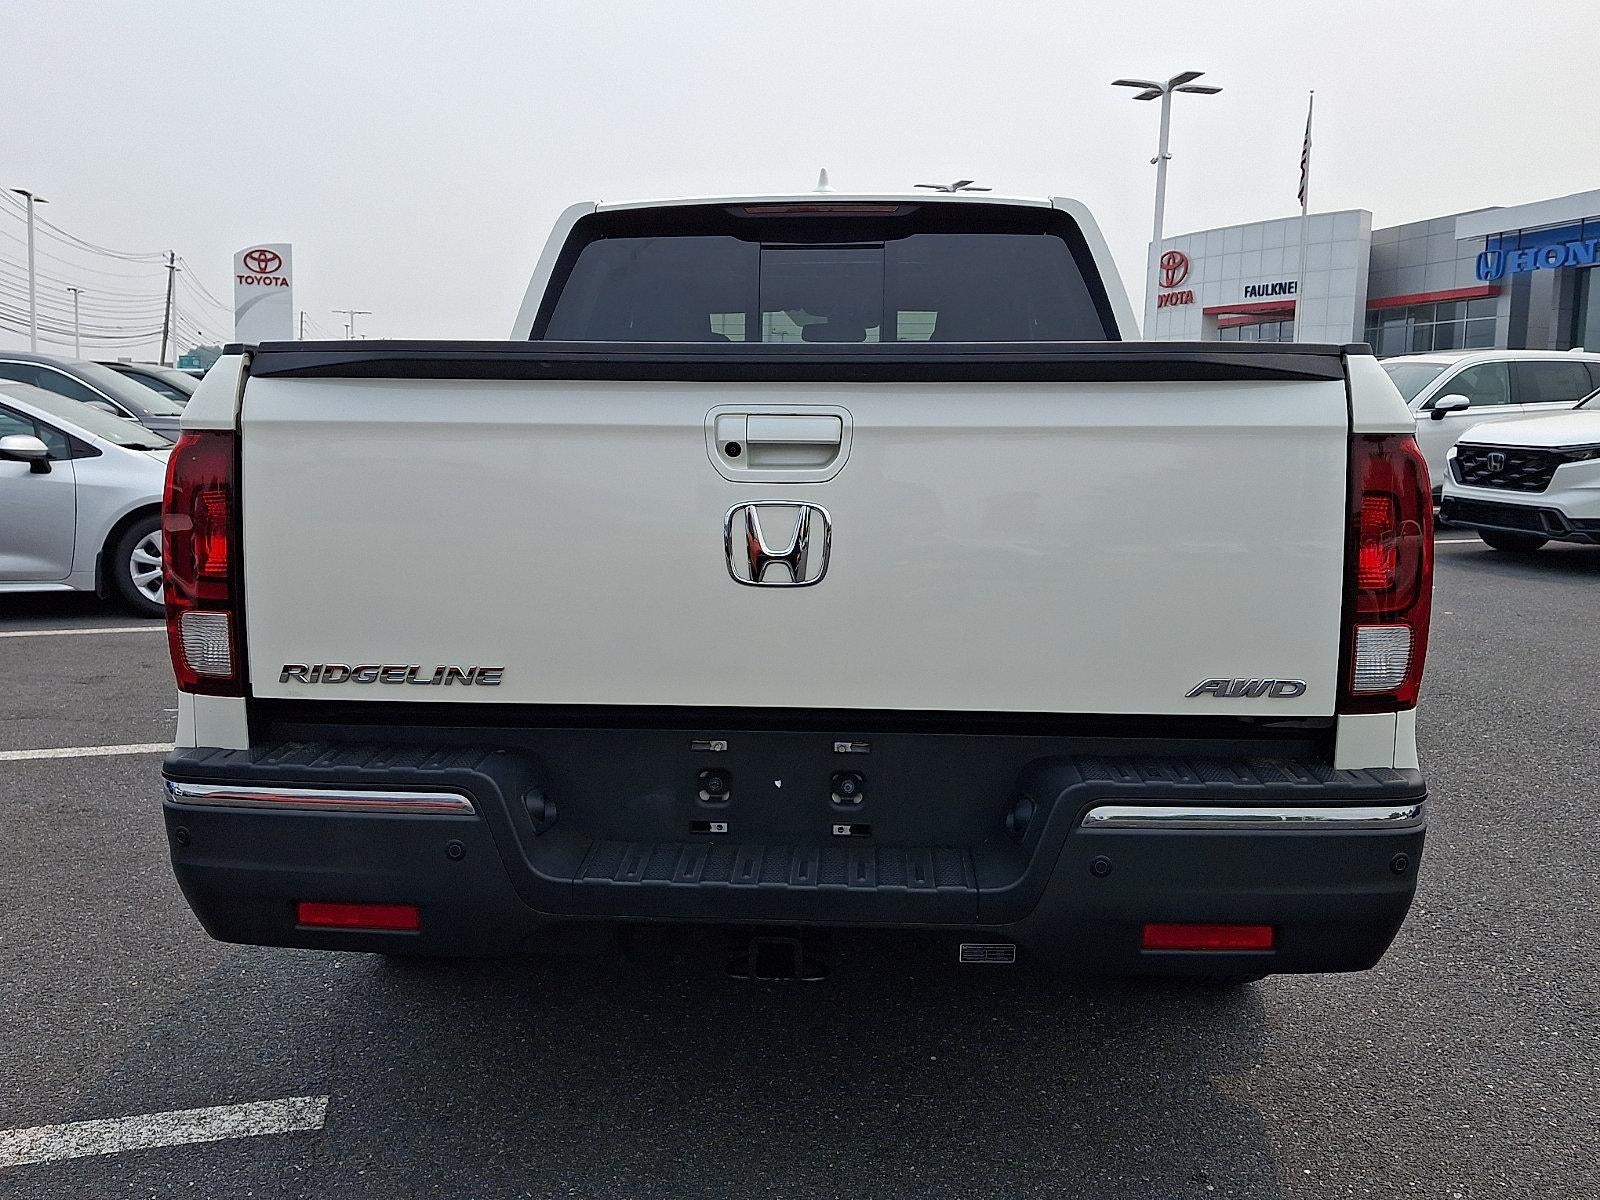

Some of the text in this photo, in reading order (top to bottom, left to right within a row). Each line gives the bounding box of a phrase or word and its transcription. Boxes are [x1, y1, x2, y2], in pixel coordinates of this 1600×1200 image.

[1508, 239, 1600, 273] HON
[237, 275, 289, 287] TOYOTA
[1244, 281, 1298, 298] FAULKNE
[278, 663, 505, 686] RIDGELINE
[1184, 678, 1307, 698] AWD
